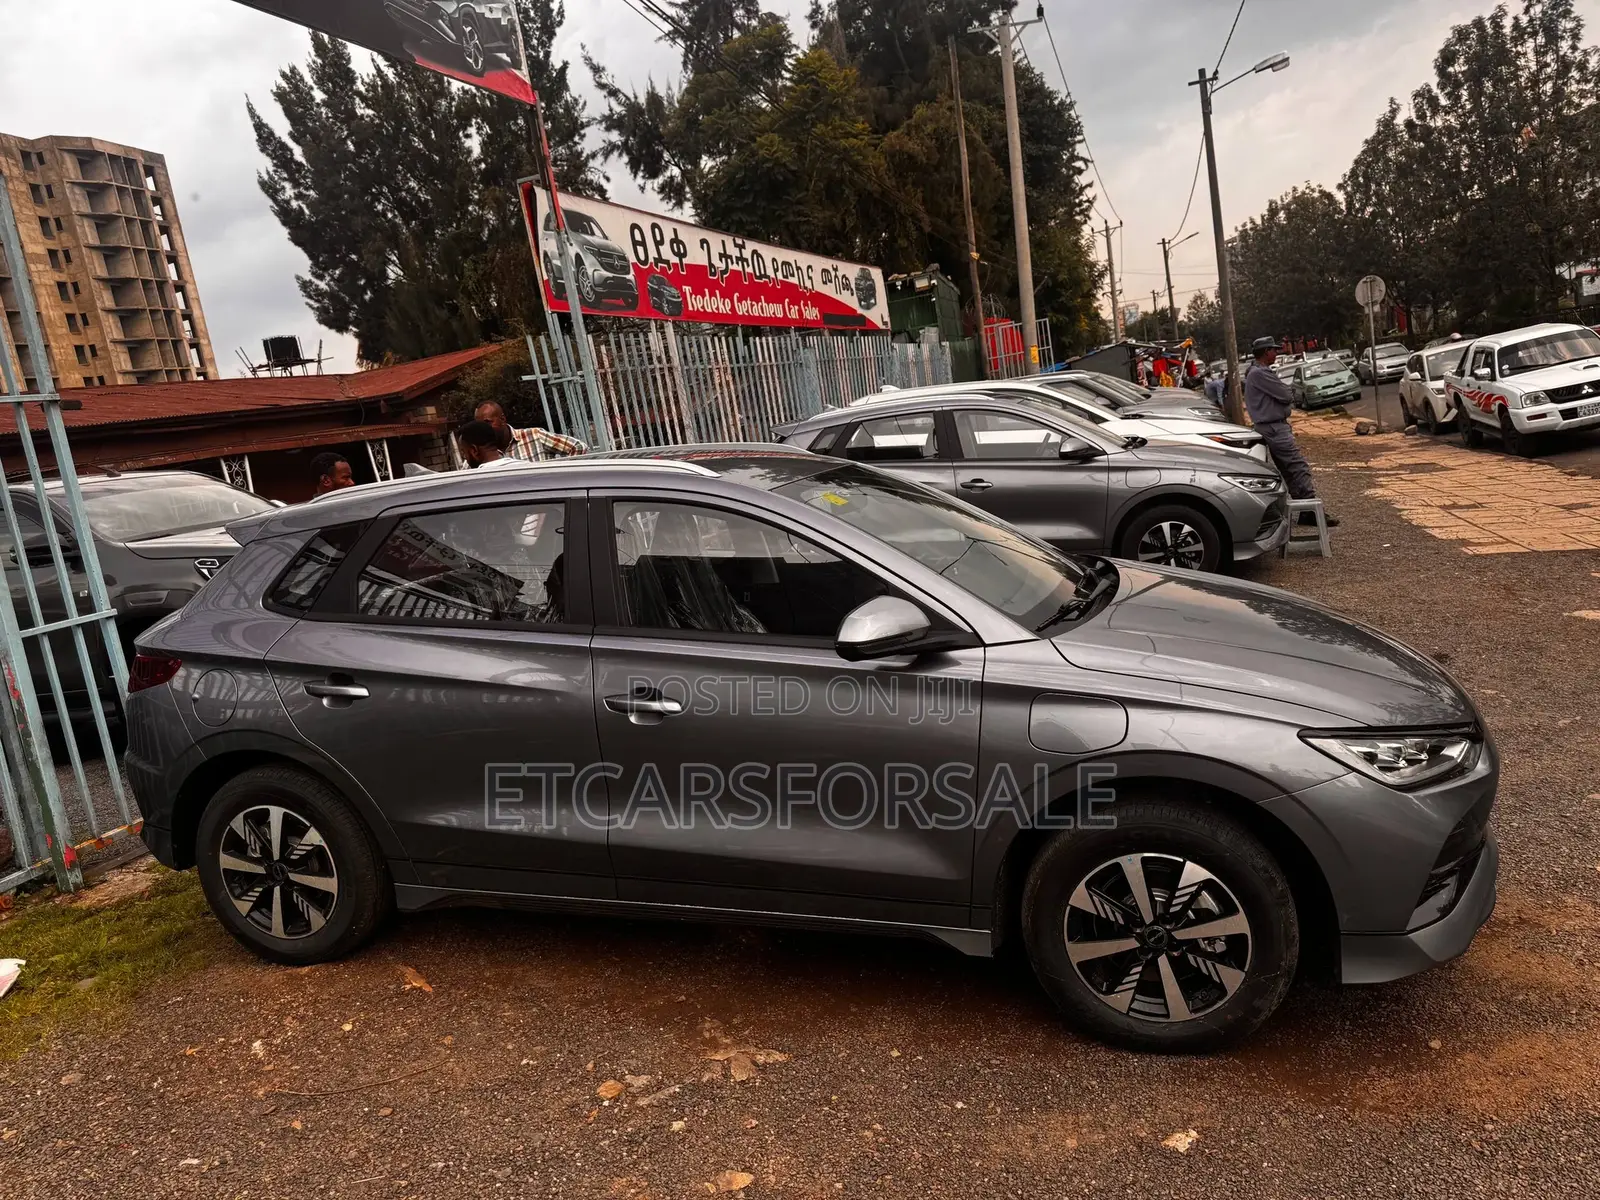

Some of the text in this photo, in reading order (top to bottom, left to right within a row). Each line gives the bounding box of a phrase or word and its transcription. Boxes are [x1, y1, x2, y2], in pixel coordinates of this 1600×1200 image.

[630, 222, 688, 273] ፀደቀ
[682, 286, 820, 320] Tsedeke Getachew Car Sales
